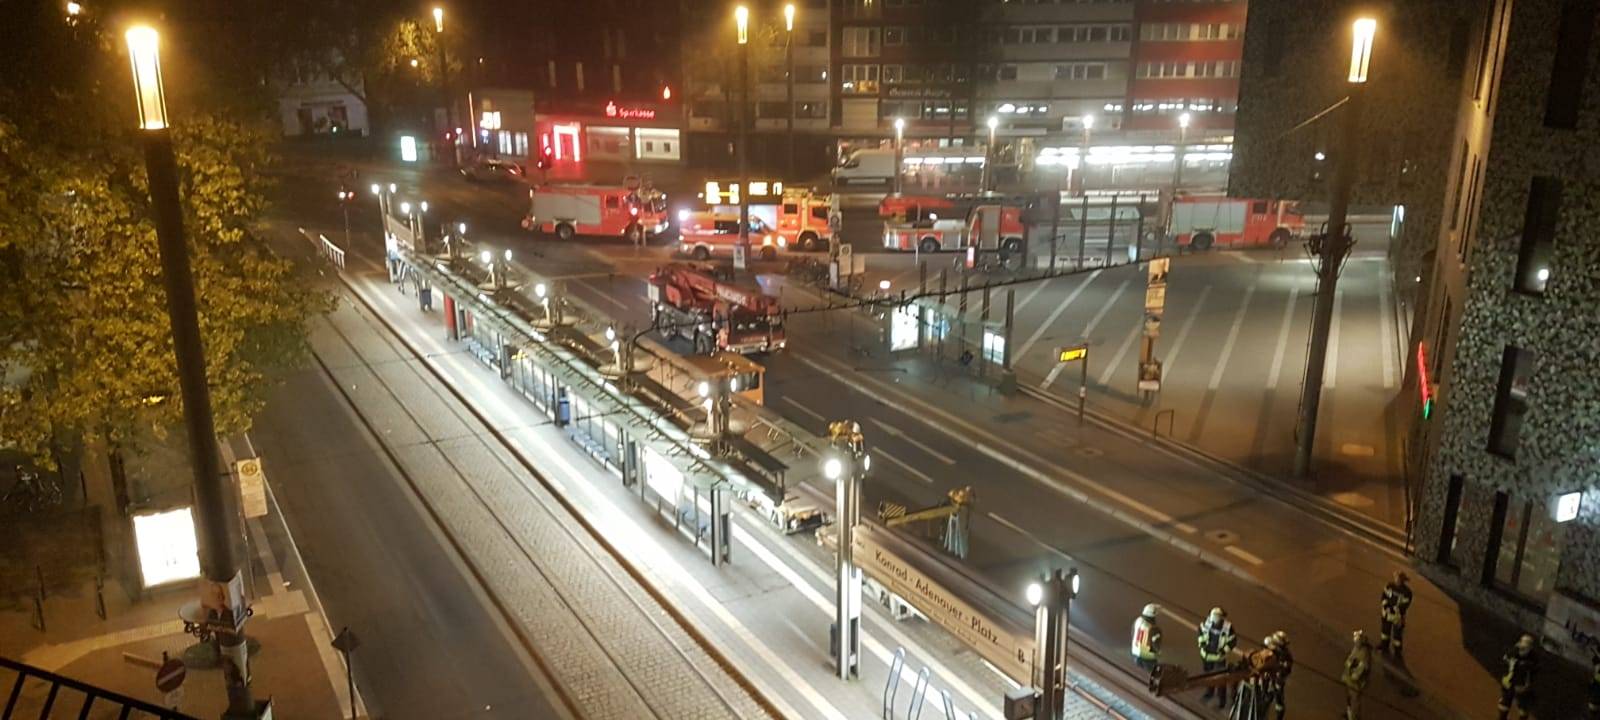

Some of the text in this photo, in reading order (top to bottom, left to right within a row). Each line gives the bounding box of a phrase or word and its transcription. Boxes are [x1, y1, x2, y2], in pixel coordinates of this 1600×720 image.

[619, 107, 655, 119] Sparkasse
[875, 549, 908, 582] Konrad
[915, 576, 963, 619] Adenauer
[971, 615, 999, 646] Platz
